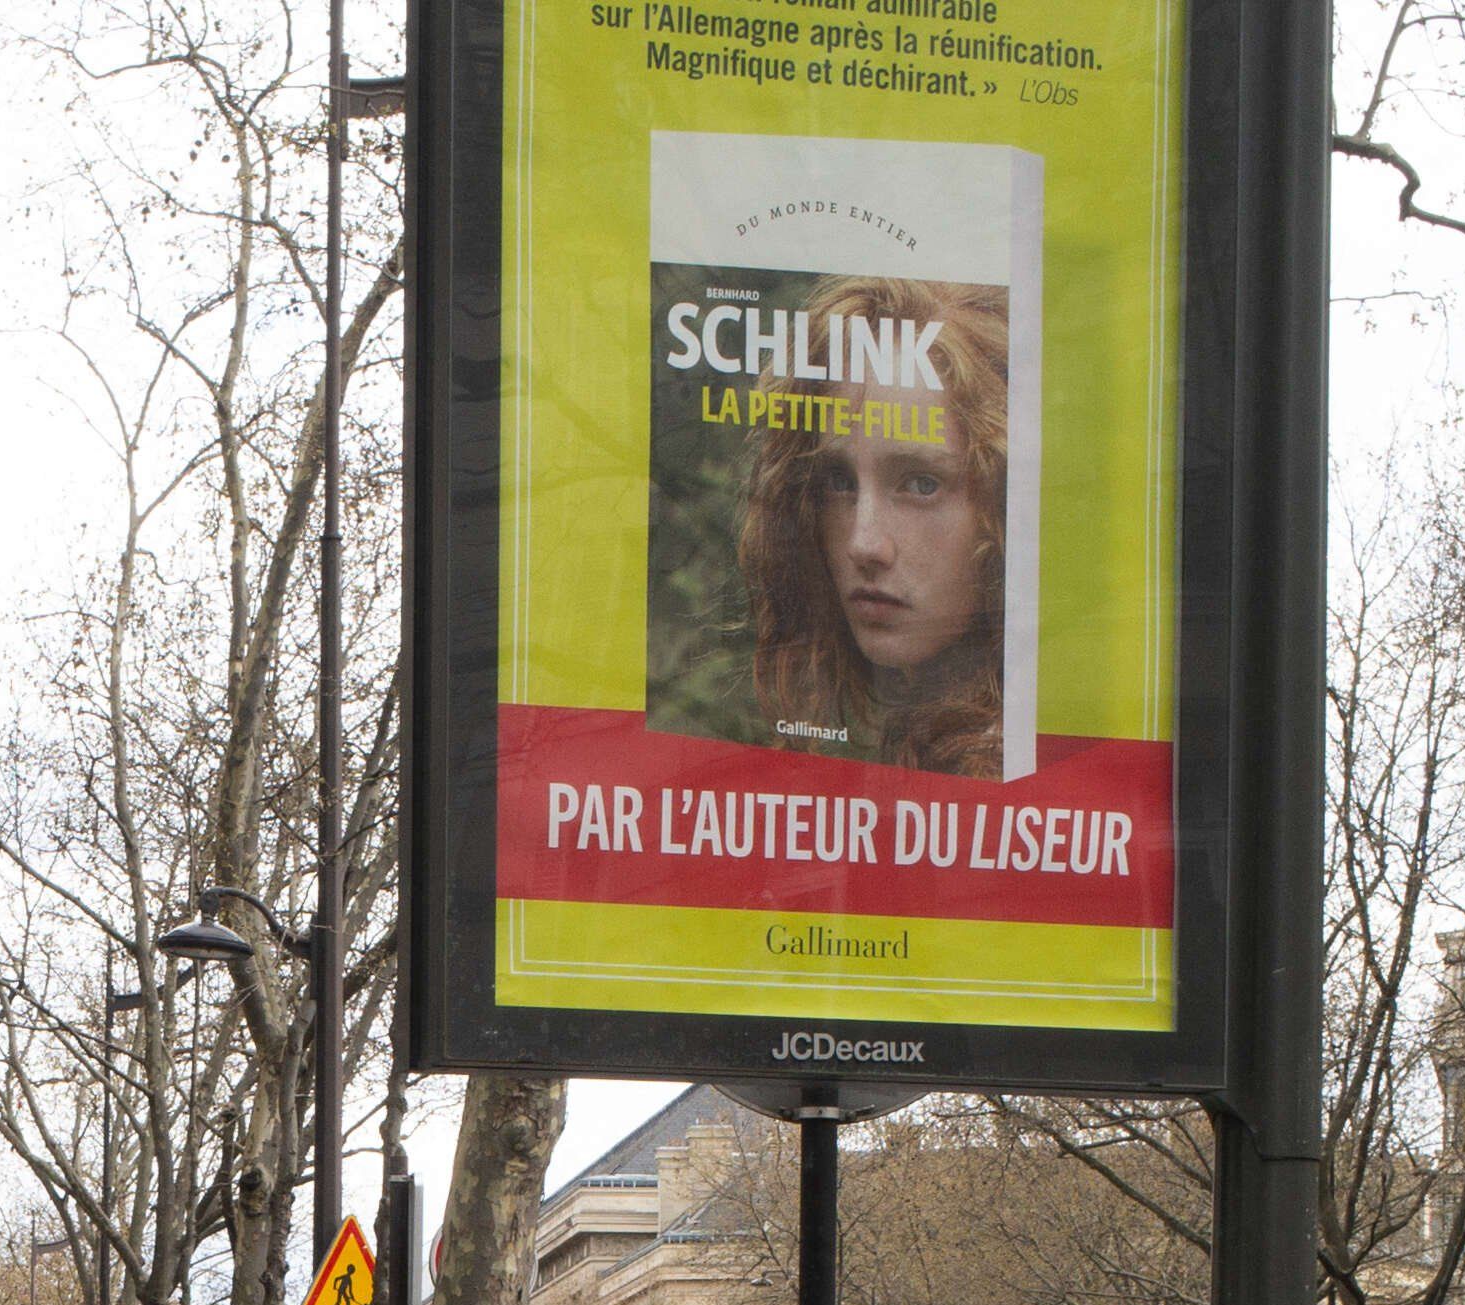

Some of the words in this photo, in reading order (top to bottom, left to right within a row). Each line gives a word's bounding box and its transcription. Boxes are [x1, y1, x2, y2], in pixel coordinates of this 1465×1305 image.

[591, 5, 633, 30] sur
[643, 4, 800, 48] l'Allemagne
[810, 20, 884, 56] après
[895, 26, 918, 54] la
[929, 28, 1104, 71] réunification.
[646, 41, 796, 86] Magnifique
[807, 62, 833, 84] et
[842, 61, 976, 97] déchirant.
[1019, 79, 1079, 106] L'Obs
[735, 215, 760, 237] DU
[769, 200, 839, 220] MONDE
[849, 205, 918, 252] ENTIER
[706, 287, 760, 301] BERNHARD
[666, 302, 945, 392] SCHLINK
[701, 385, 741, 425] LA
[748, 389, 946, 444] PETITE-FILLE
[776, 719, 849, 743] Gallimard
[547, 782, 645, 853] PAR
[660, 787, 879, 865] L'AUTEUR
[893, 799, 959, 868] DU
[969, 803, 1133, 877] LISEUR
[765, 923, 910, 961] Gallimard
[772, 1031, 925, 1063] JCDecaux
